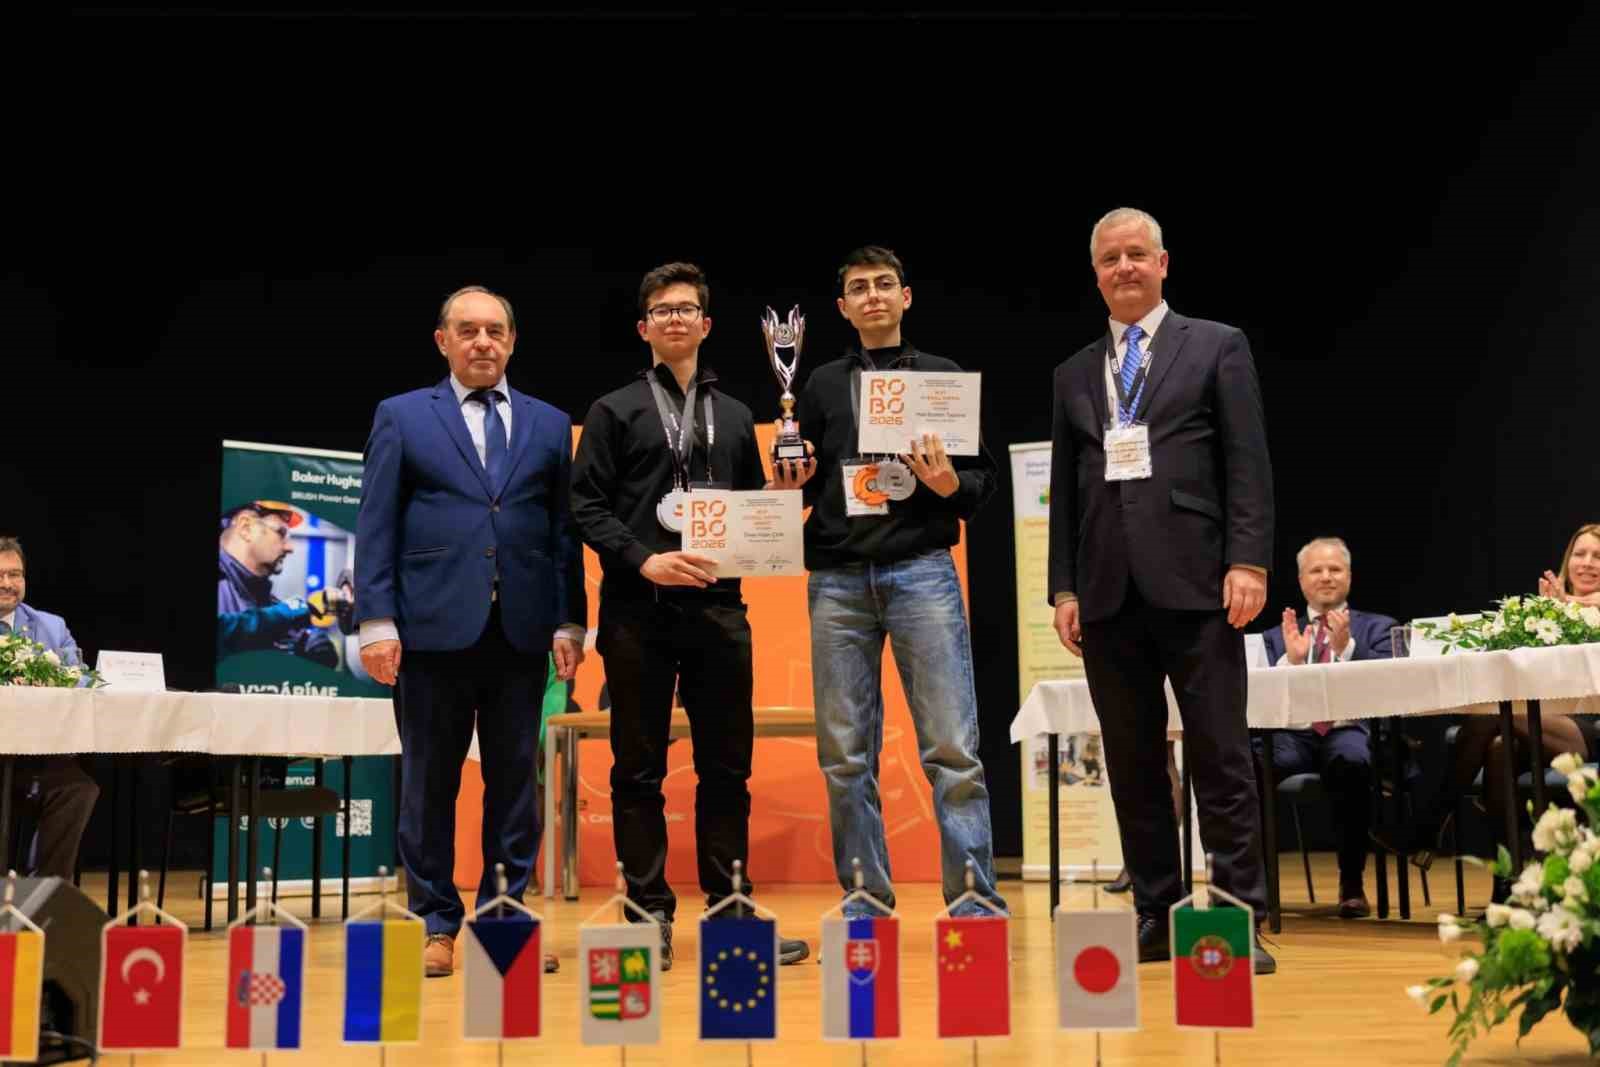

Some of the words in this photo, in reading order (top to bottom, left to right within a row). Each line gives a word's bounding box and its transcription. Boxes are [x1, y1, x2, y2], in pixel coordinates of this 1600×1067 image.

[871, 378, 905, 395] RO
[870, 397, 904, 414] BO
[869, 416, 903, 425] 2026
[292, 471, 326, 483] Baker
[691, 500, 726, 518] RO
[691, 520, 726, 537] BO
[690, 539, 726, 549] 2026
